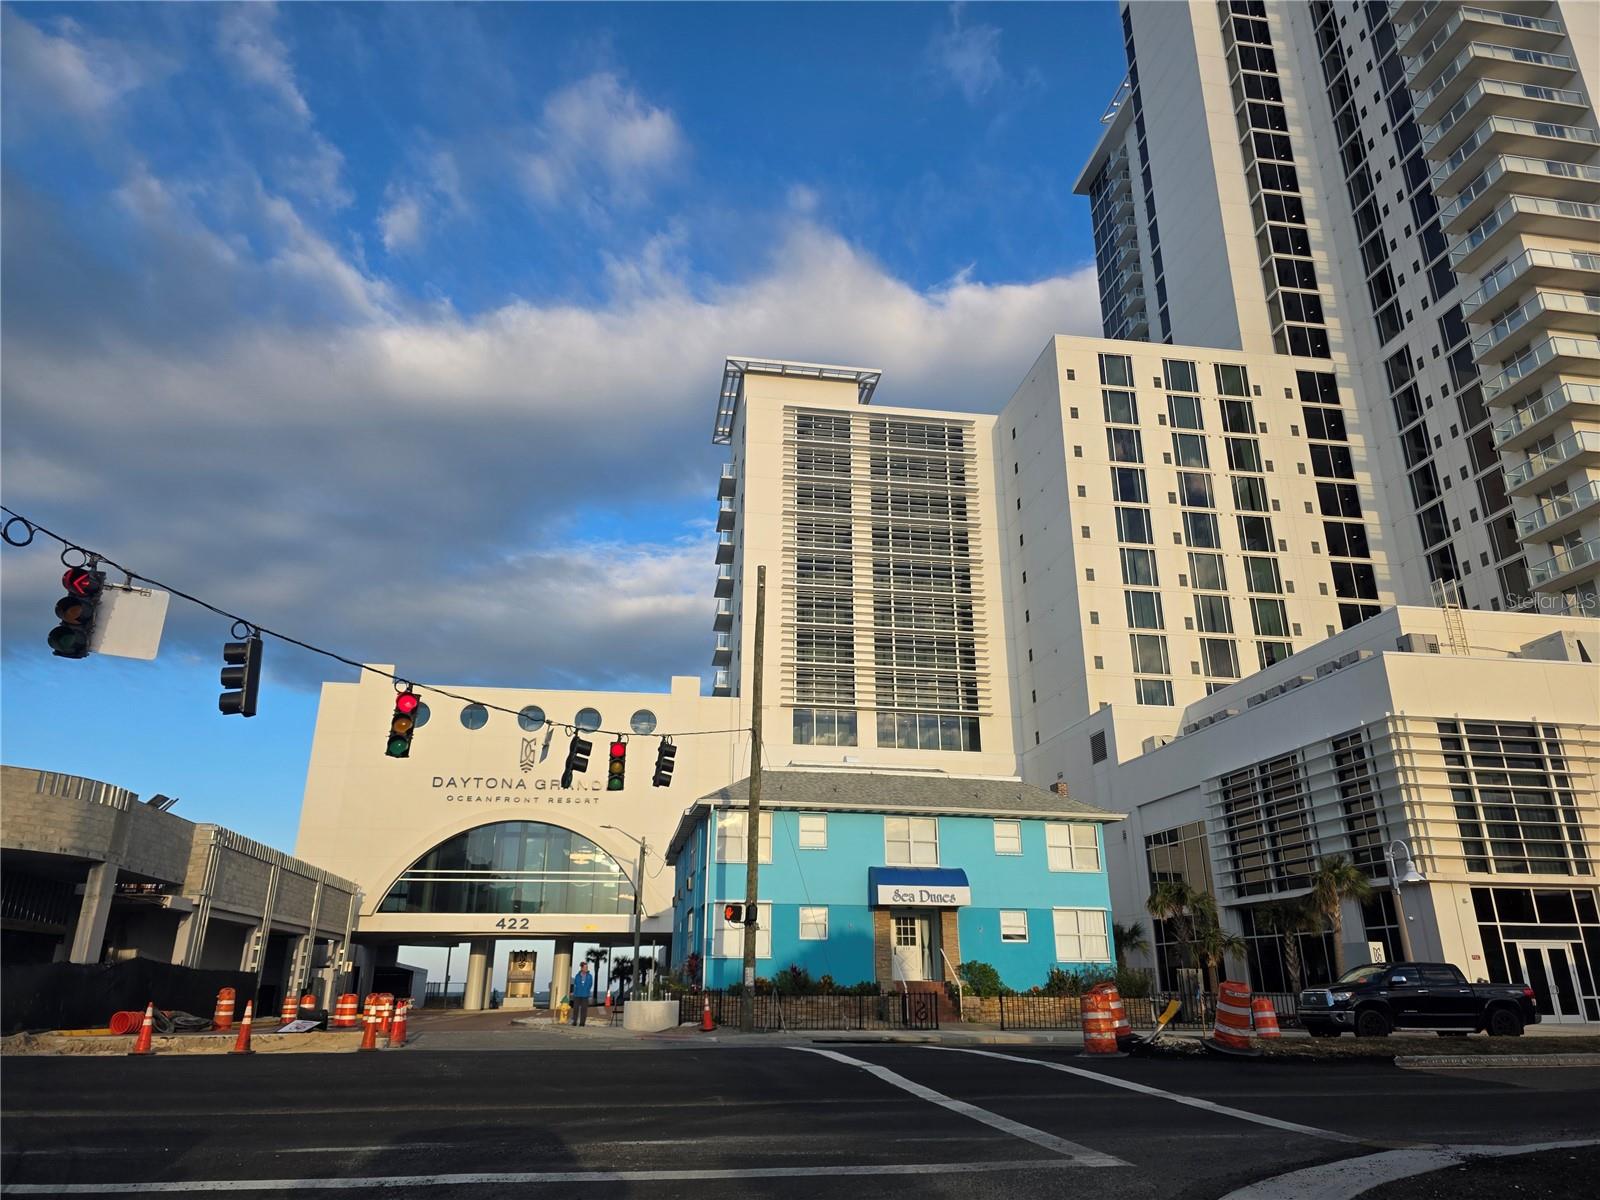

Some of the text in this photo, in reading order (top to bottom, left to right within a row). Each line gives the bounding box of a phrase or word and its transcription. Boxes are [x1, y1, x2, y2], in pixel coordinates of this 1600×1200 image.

[432, 776, 603, 791] DAYTONA GRND
[446, 795, 540, 803] OCEANFRONT
[892, 889, 957, 903] Sea Dunes
[495, 918, 530, 930] 422
